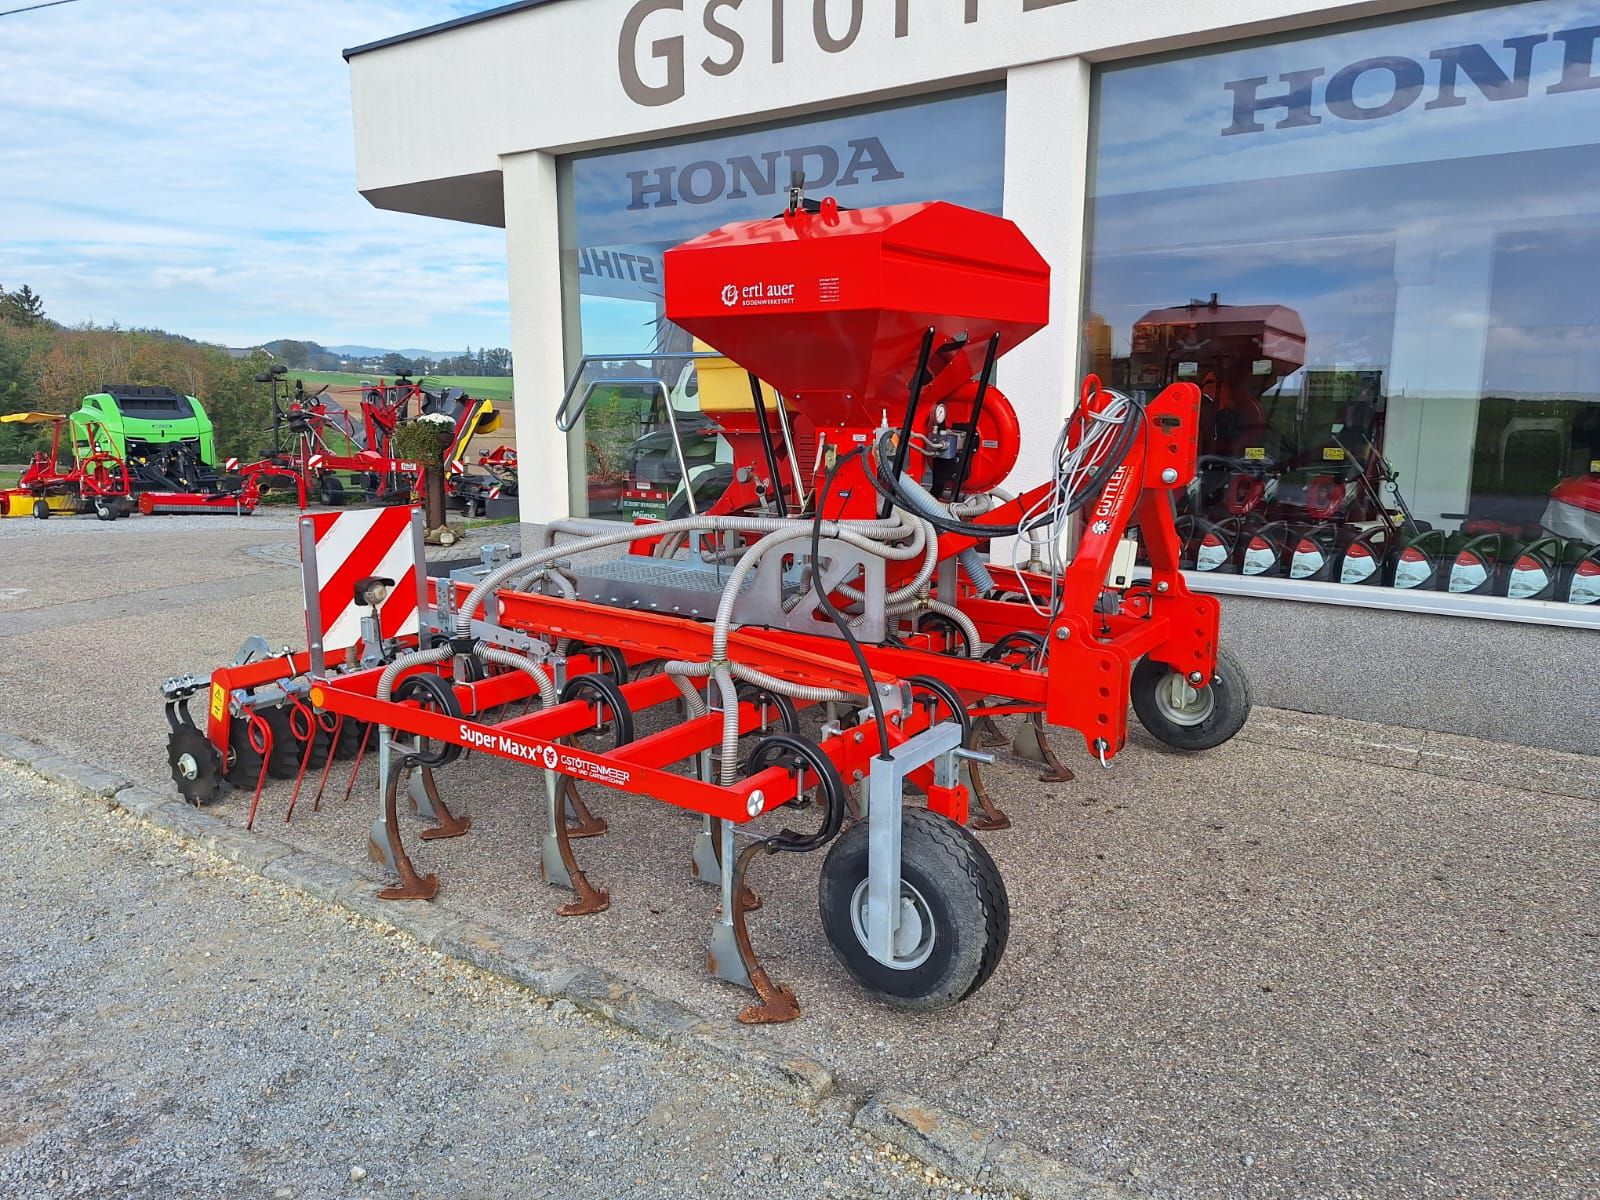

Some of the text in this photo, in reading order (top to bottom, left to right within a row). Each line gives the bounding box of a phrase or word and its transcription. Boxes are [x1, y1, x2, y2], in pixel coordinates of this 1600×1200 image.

[625, 136, 904, 211] HONDA
[742, 282, 795, 298] ertl auer
[742, 298, 795, 306] BODENWERKSTATT
[1095, 465, 1128, 517] GÜTTLER
[459, 723, 498, 749] Super
